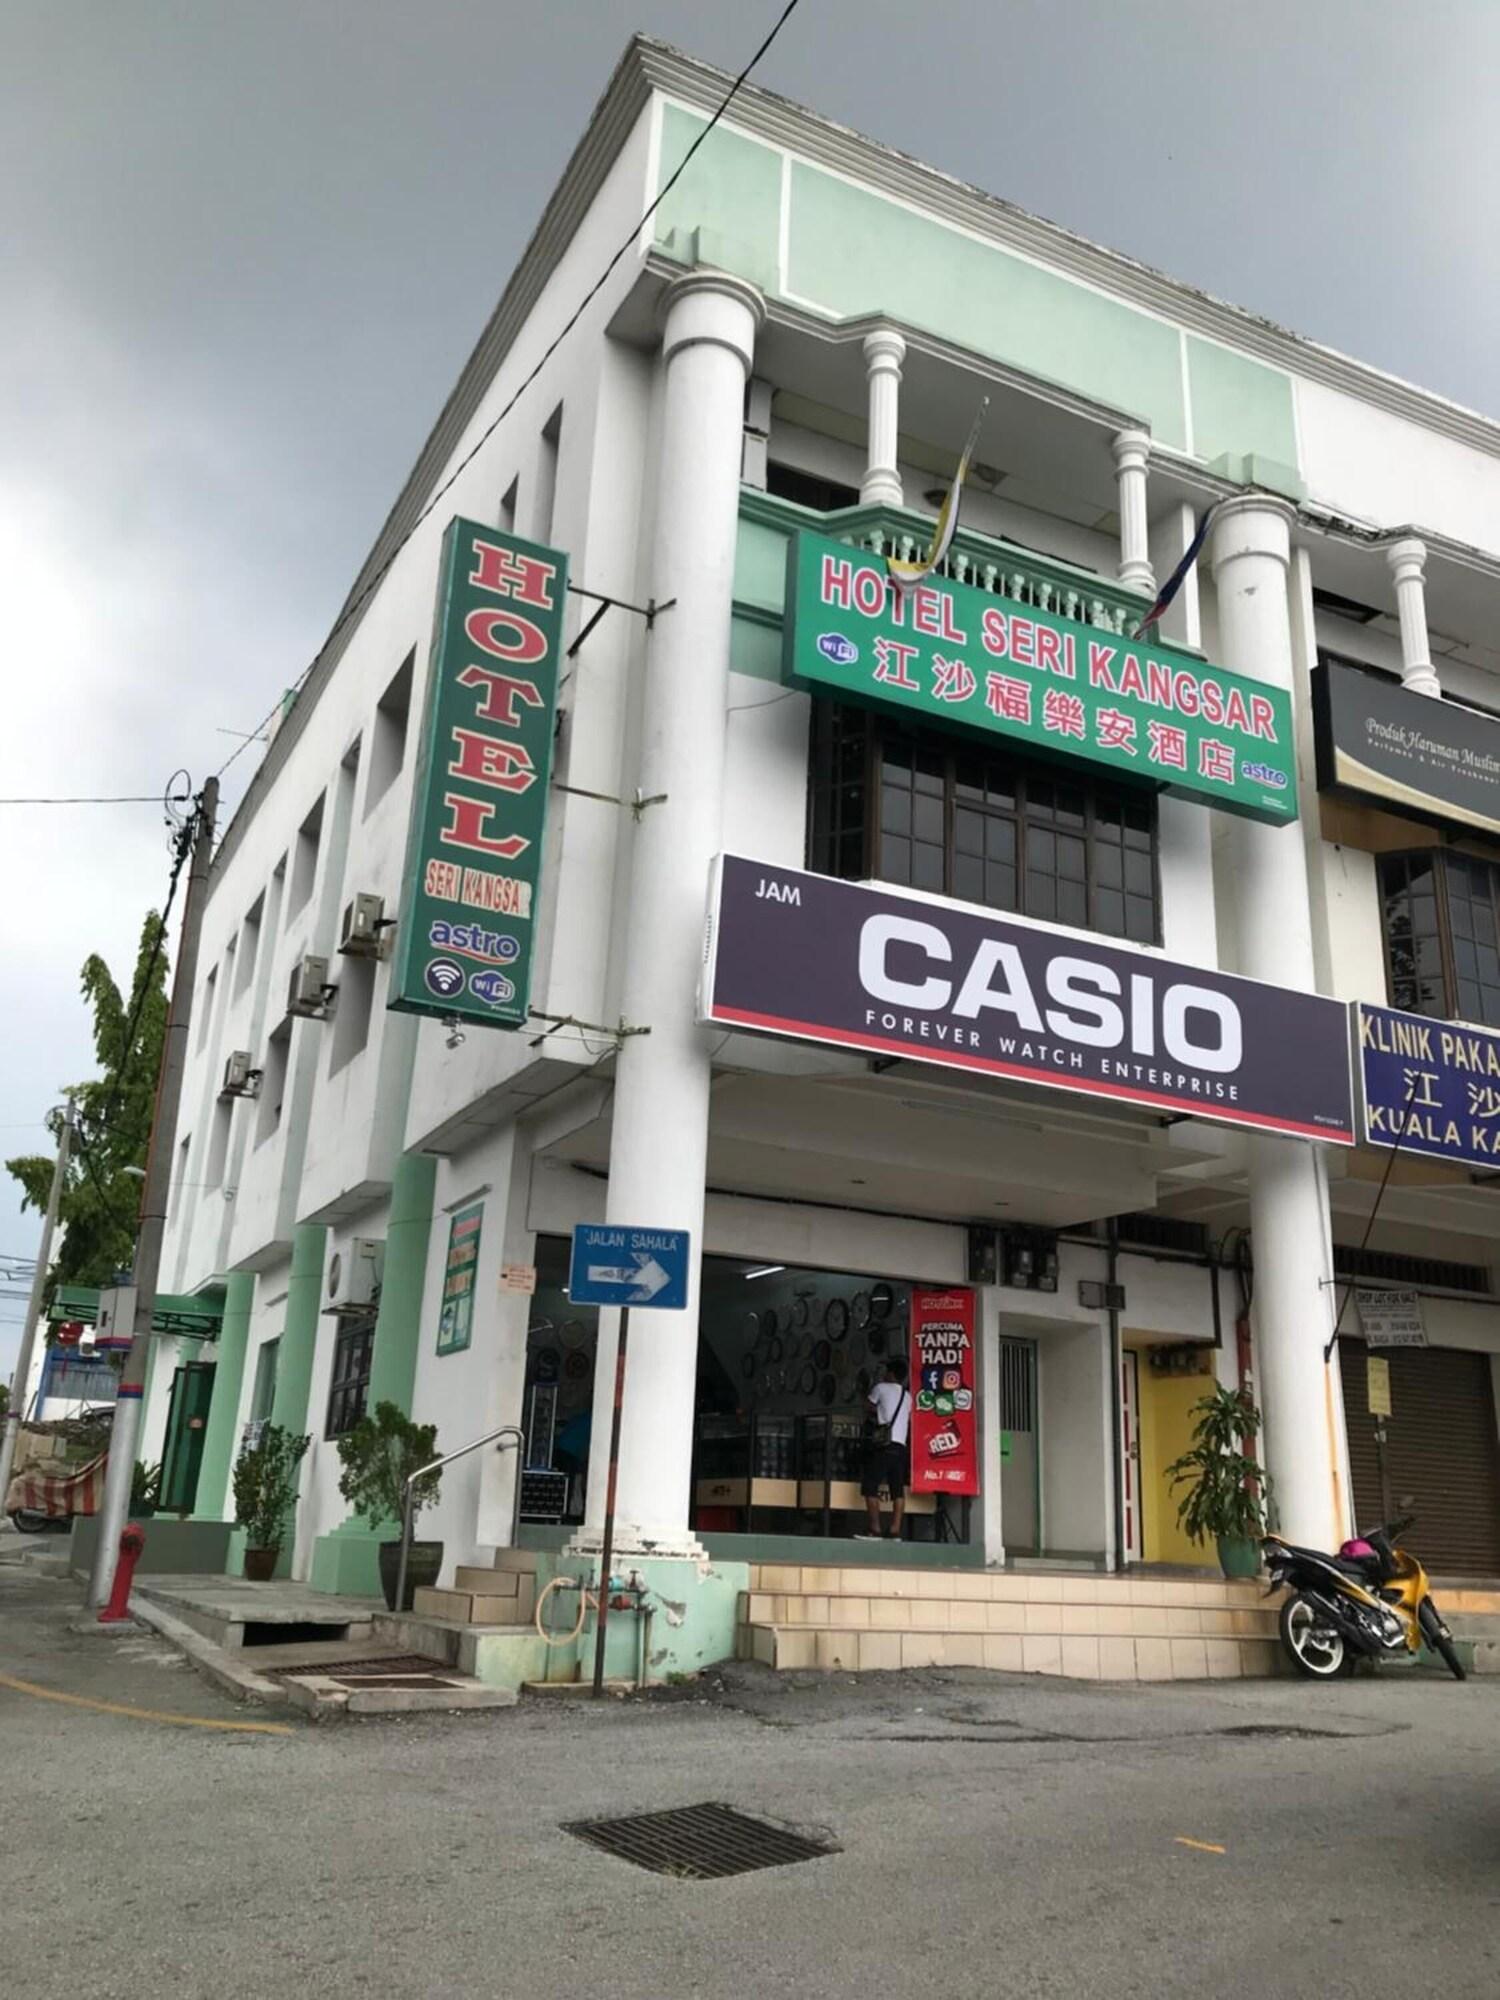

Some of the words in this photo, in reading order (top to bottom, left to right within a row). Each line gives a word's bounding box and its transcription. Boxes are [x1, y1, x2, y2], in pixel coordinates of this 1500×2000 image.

[821, 554, 967, 645] HOTEL
[982, 608, 1077, 680] SERI
[1089, 641, 1278, 744] KANGSAR
[440, 539, 557, 861] HOTEL
[872, 636, 1235, 785] 江沙福樂安酒店
[1366, 717, 1405, 745] Produk
[1403, 731, 1460, 761] Haruman
[1242, 762, 1287, 787] astro
[425, 859, 461, 903] SERI
[755, 879, 802, 906] JAM
[430, 921, 518, 960] astro
[858, 913, 1243, 1074] CASIO
[866, 1009, 981, 1048] FOREVER
[999, 1036, 1083, 1069] WATCH
[1101, 1058, 1240, 1100] ENTERPRISE
[1361, 1013, 1435, 1063] KLINIK
[1368, 1104, 1462, 1147] KUALA
[586, 1231, 625, 1247] JALAN
[915, 1332, 970, 1348] TANPA
[921, 1322, 964, 1331] PERCUMA
[921, 1349, 963, 1365] HAD!
[929, 1432, 959, 1454] RED
